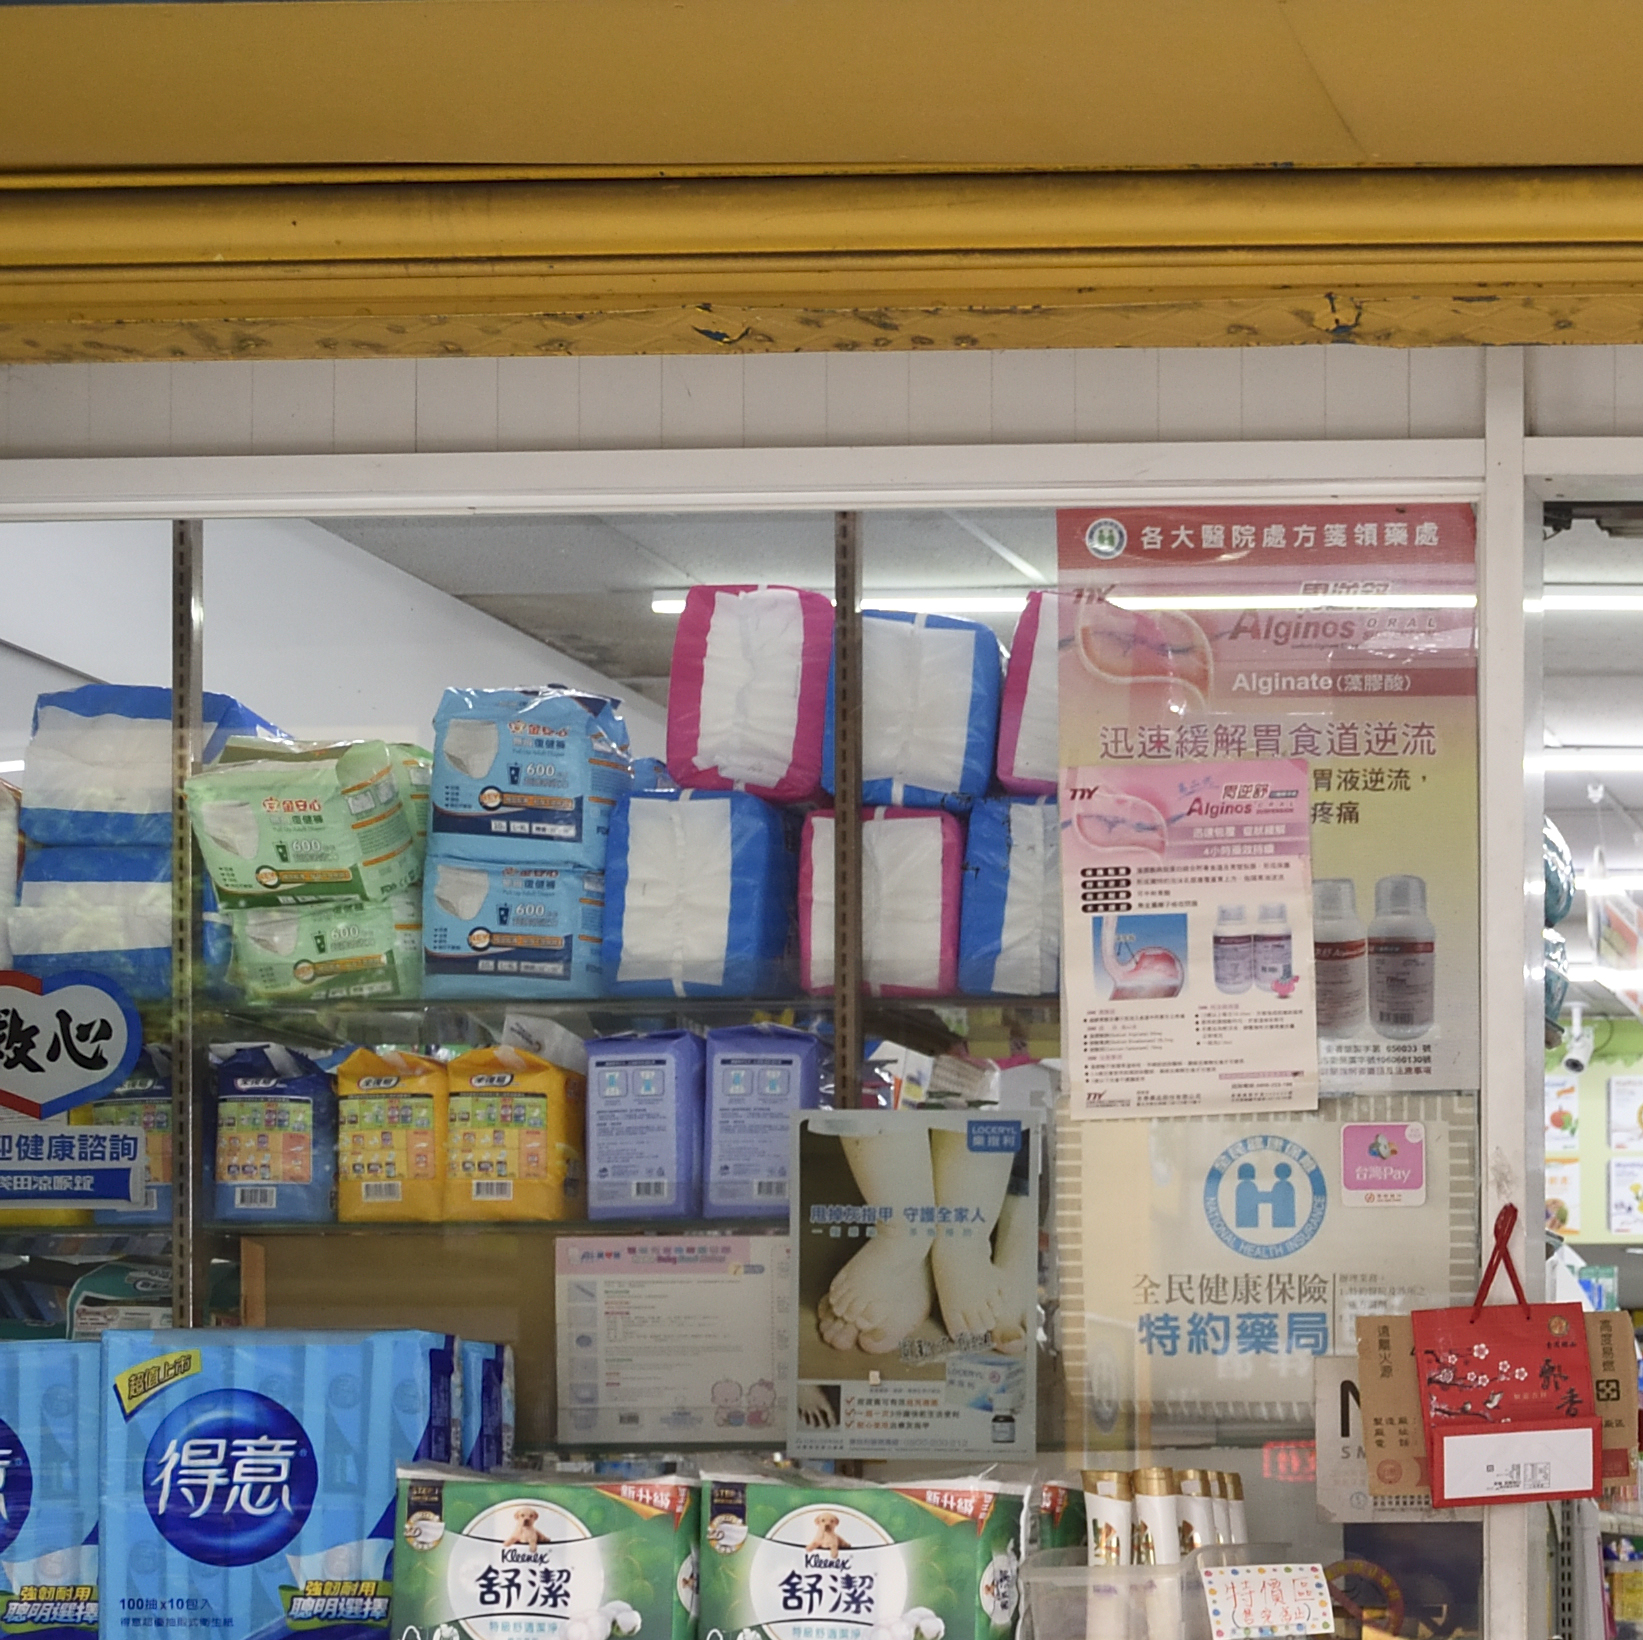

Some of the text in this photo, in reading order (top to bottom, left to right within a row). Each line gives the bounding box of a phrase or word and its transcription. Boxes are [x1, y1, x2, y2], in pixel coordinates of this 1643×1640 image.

[1140, 522, 1440, 550] 各大醫院處方箋領藥處
[1228, 608, 1356, 645] Alginos
[1231, 672, 1333, 696] Alginate
[1100, 722, 1437, 758] 迅速緩解胃食道逆流
[526, 763, 555, 777] 600
[1187, 797, 1252, 818] Alginos
[1311, 801, 1359, 824] 疼痛
[292, 839, 322, 853] 600
[515, 904, 544, 916] 600
[330, 925, 360, 941] 600
[1355, 1166, 1411, 1183] 台灣Pay
[810, 1205, 986, 1223] 甩掉灰指甲 守護全家人
[1205, 1195, 1326, 1258] NATIONAL HEALTH INSURANCE
[1131, 1273, 1329, 1306] 全民健康保險
[1138, 1311, 1329, 1356] 特約藥局
[1377, 1325, 1394, 1379] 遠離火源
[126, 1354, 193, 1399] 超值上市
[155, 1435, 298, 1518] 得意
[620, 1485, 670, 1510] 新升級
[926, 1491, 974, 1515] 新升級
[501, 1549, 549, 1565] Kleenex
[804, 1554, 851, 1570] Kleenex
[20, 1585, 93, 1602] 強韌耐用
[304, 1581, 377, 1597] 強韌耐用
[475, 1565, 571, 1609] 舒潔
[778, 1570, 874, 1614] 舒潔
[1225, 1577, 1315, 1608] 特價區
[3, 1601, 99, 1624] 聰明選擇
[289, 1596, 390, 1621] 聰明選擇
[489, 1621, 558, 1634] 特級舒適潔淨
